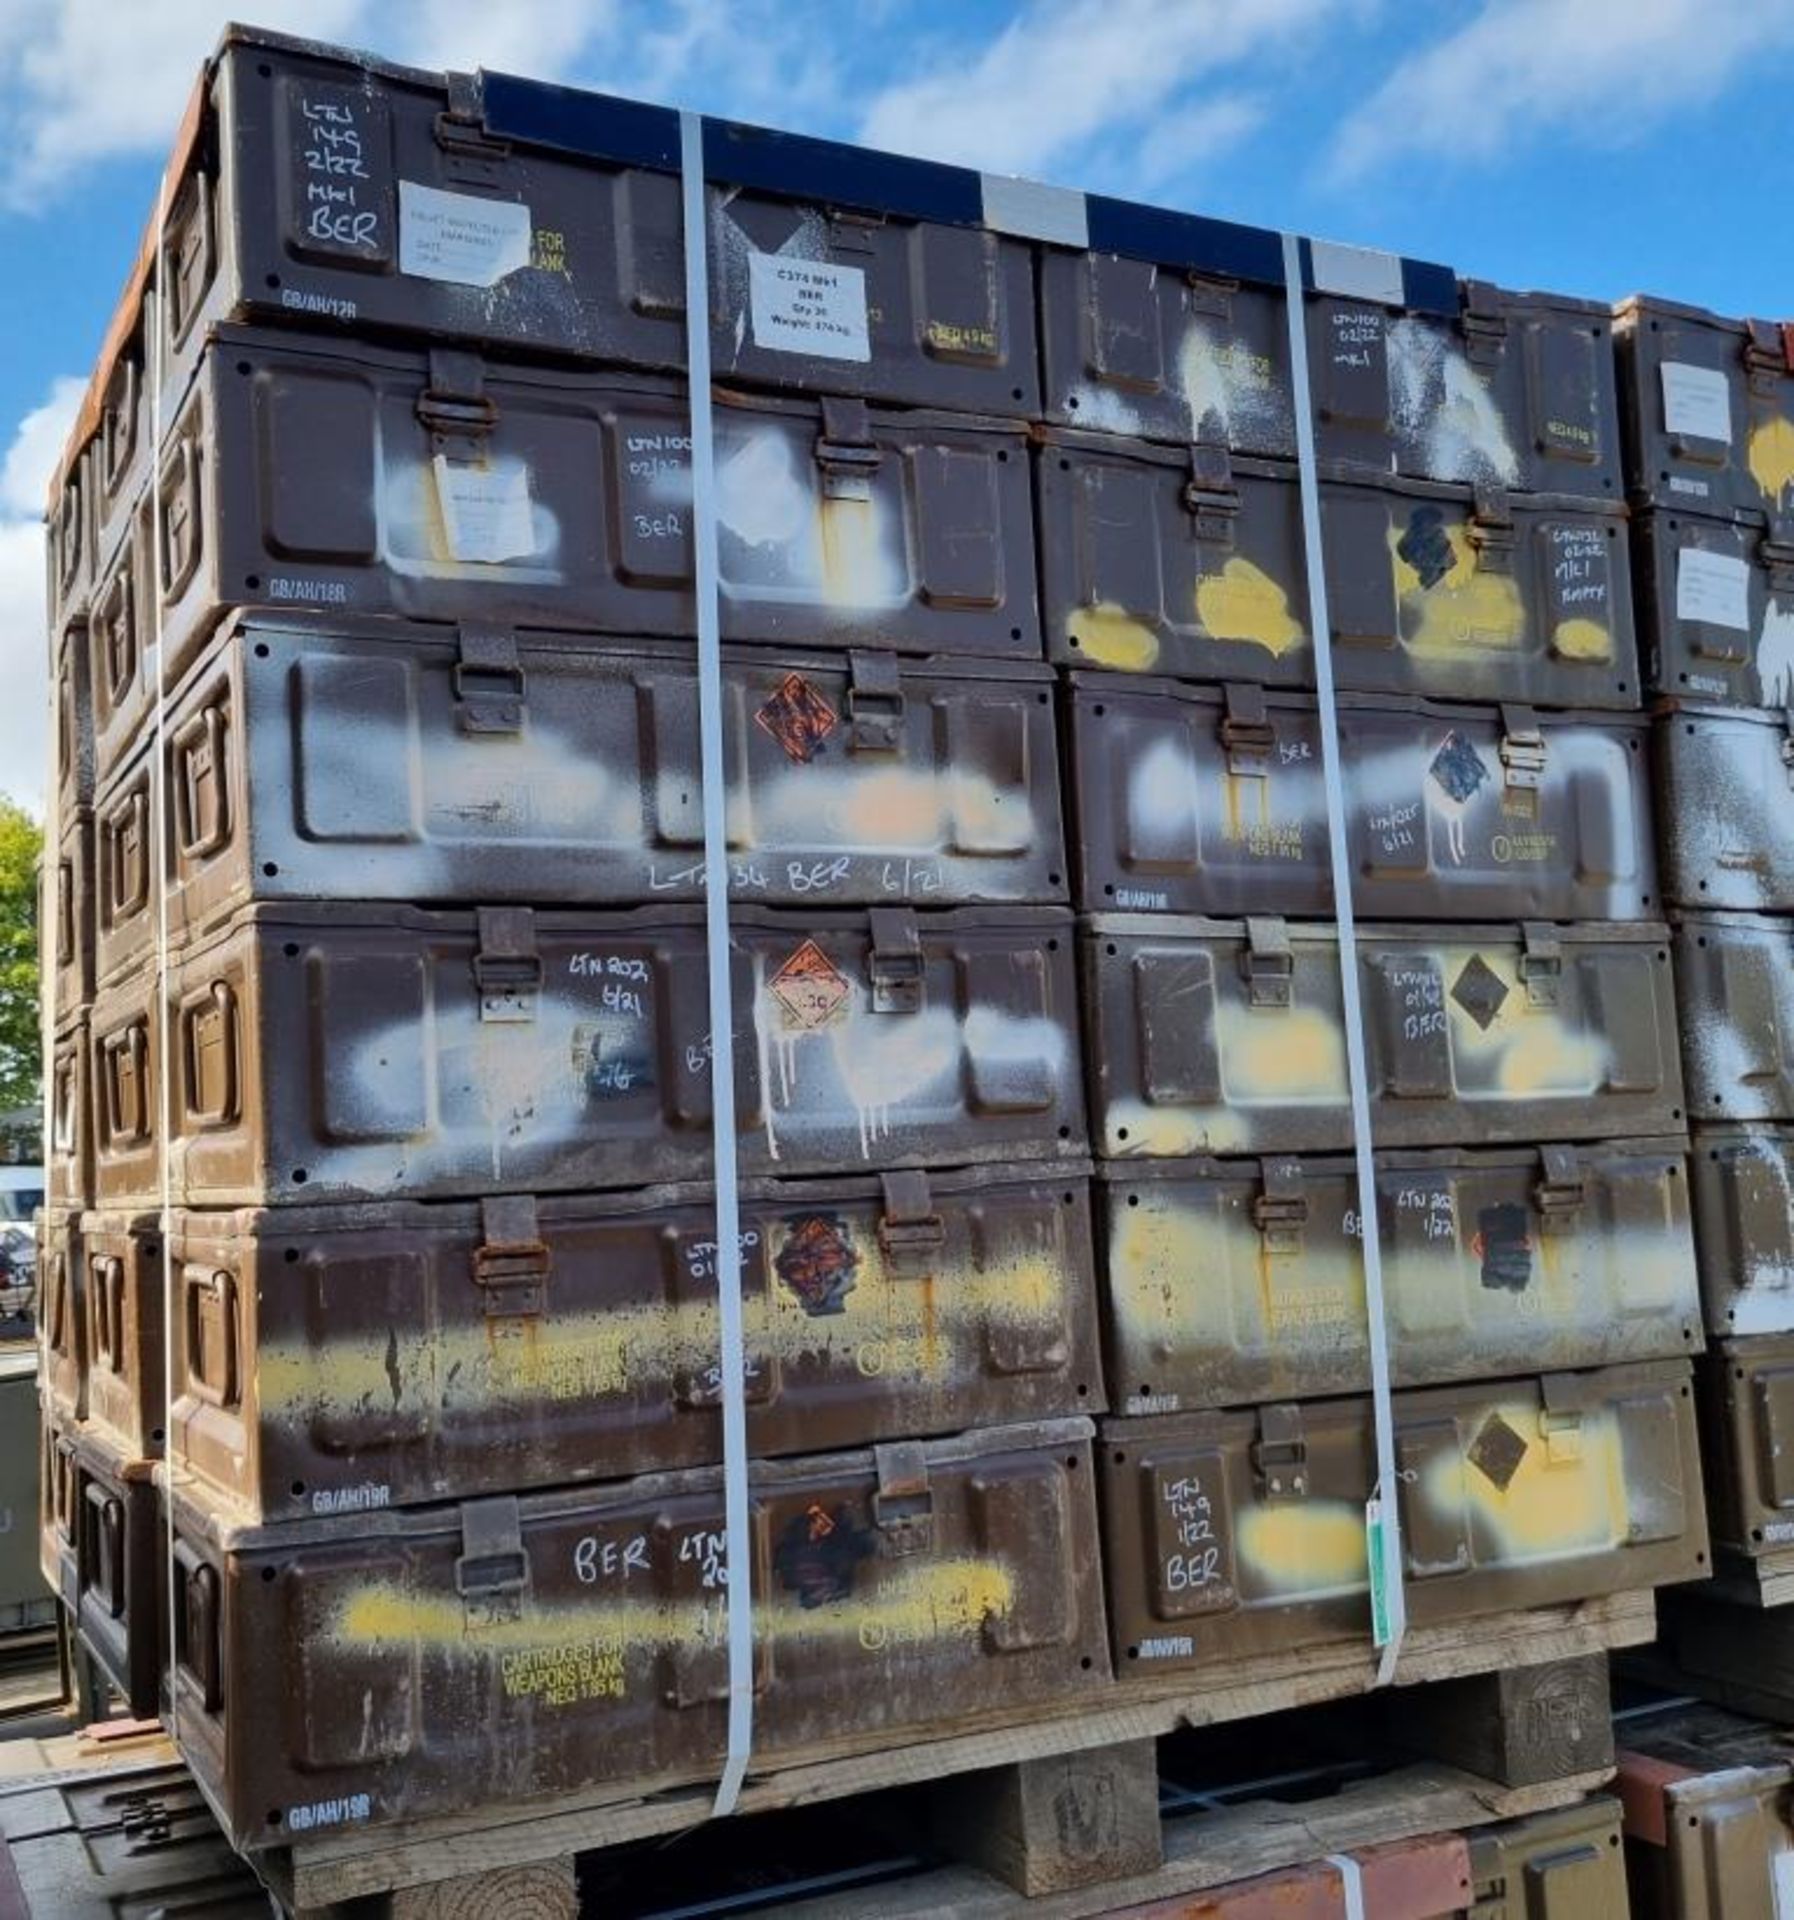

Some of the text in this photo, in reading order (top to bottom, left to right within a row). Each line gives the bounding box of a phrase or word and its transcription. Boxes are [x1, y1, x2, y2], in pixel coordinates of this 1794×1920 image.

[304, 147, 370, 179] 2/22
[307, 205, 378, 249] BER
[536, 230, 565, 251] FOR
[787, 855, 850, 891] BER
[569, 952, 602, 976] LTN
[574, 1535, 651, 1583] BER
[1166, 1546, 1222, 1591] BER
[501, 1643, 592, 1676] CARTRIDGES
[504, 1655, 625, 1698] WEAPONS BLANK
[545, 1684, 577, 1706] NEQ
